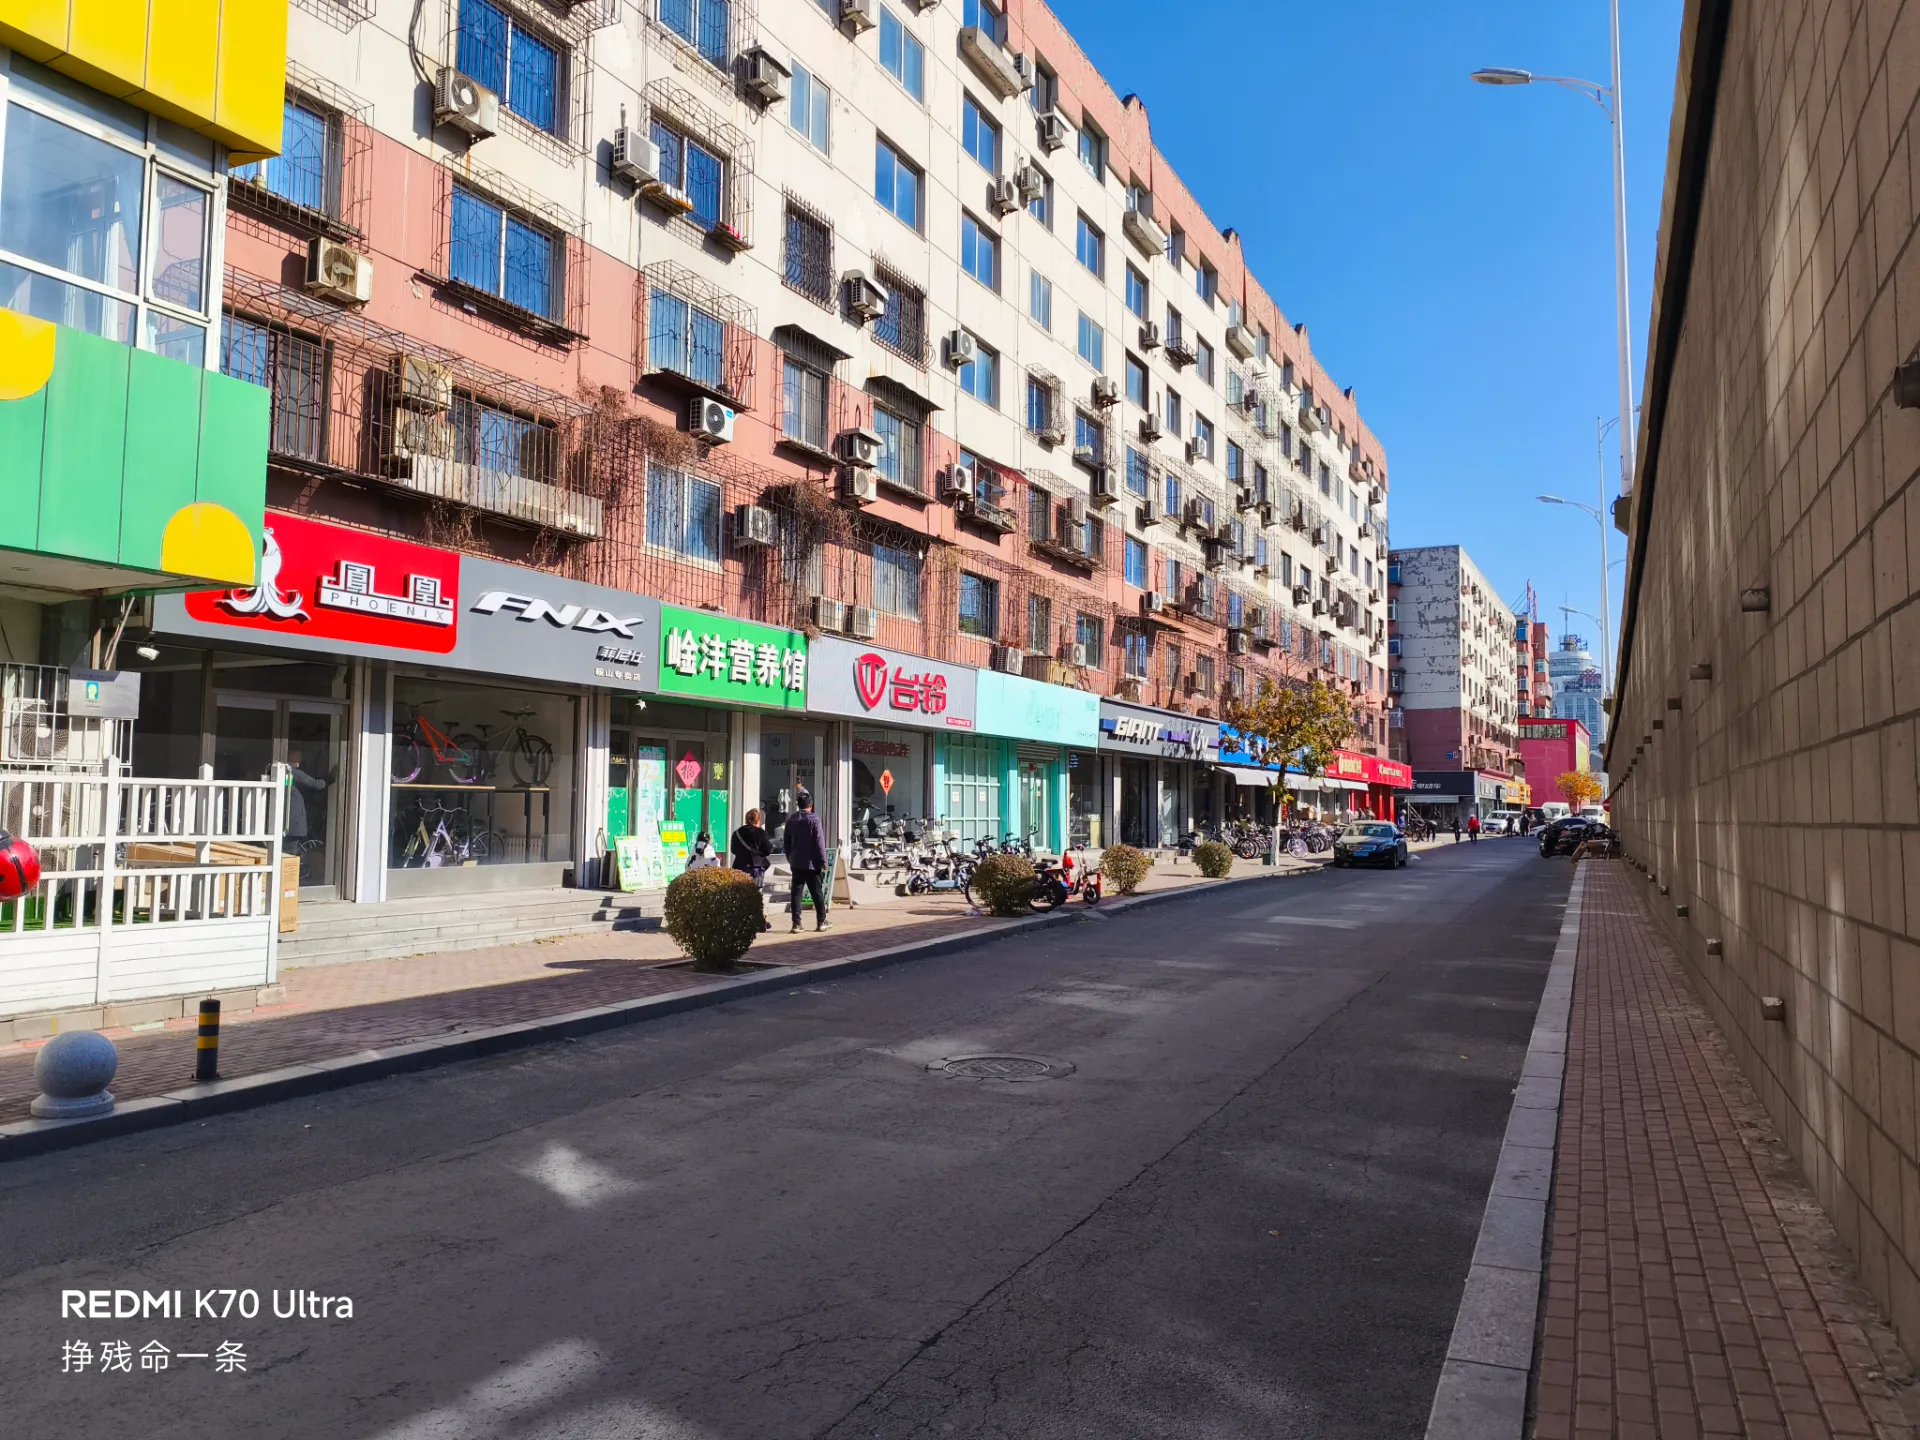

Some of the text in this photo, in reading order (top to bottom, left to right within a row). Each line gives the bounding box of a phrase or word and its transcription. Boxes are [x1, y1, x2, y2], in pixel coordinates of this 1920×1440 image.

[330, 591, 444, 621] PHOENIX
[473, 591, 646, 639] FNIX
[598, 646, 645, 665] 菲尼仕
[595, 667, 641, 682] 鞍山专卖店
[891, 666, 947, 713] 台铃
[1113, 716, 1164, 741] GIANT
[680, 764, 695, 780] 福
